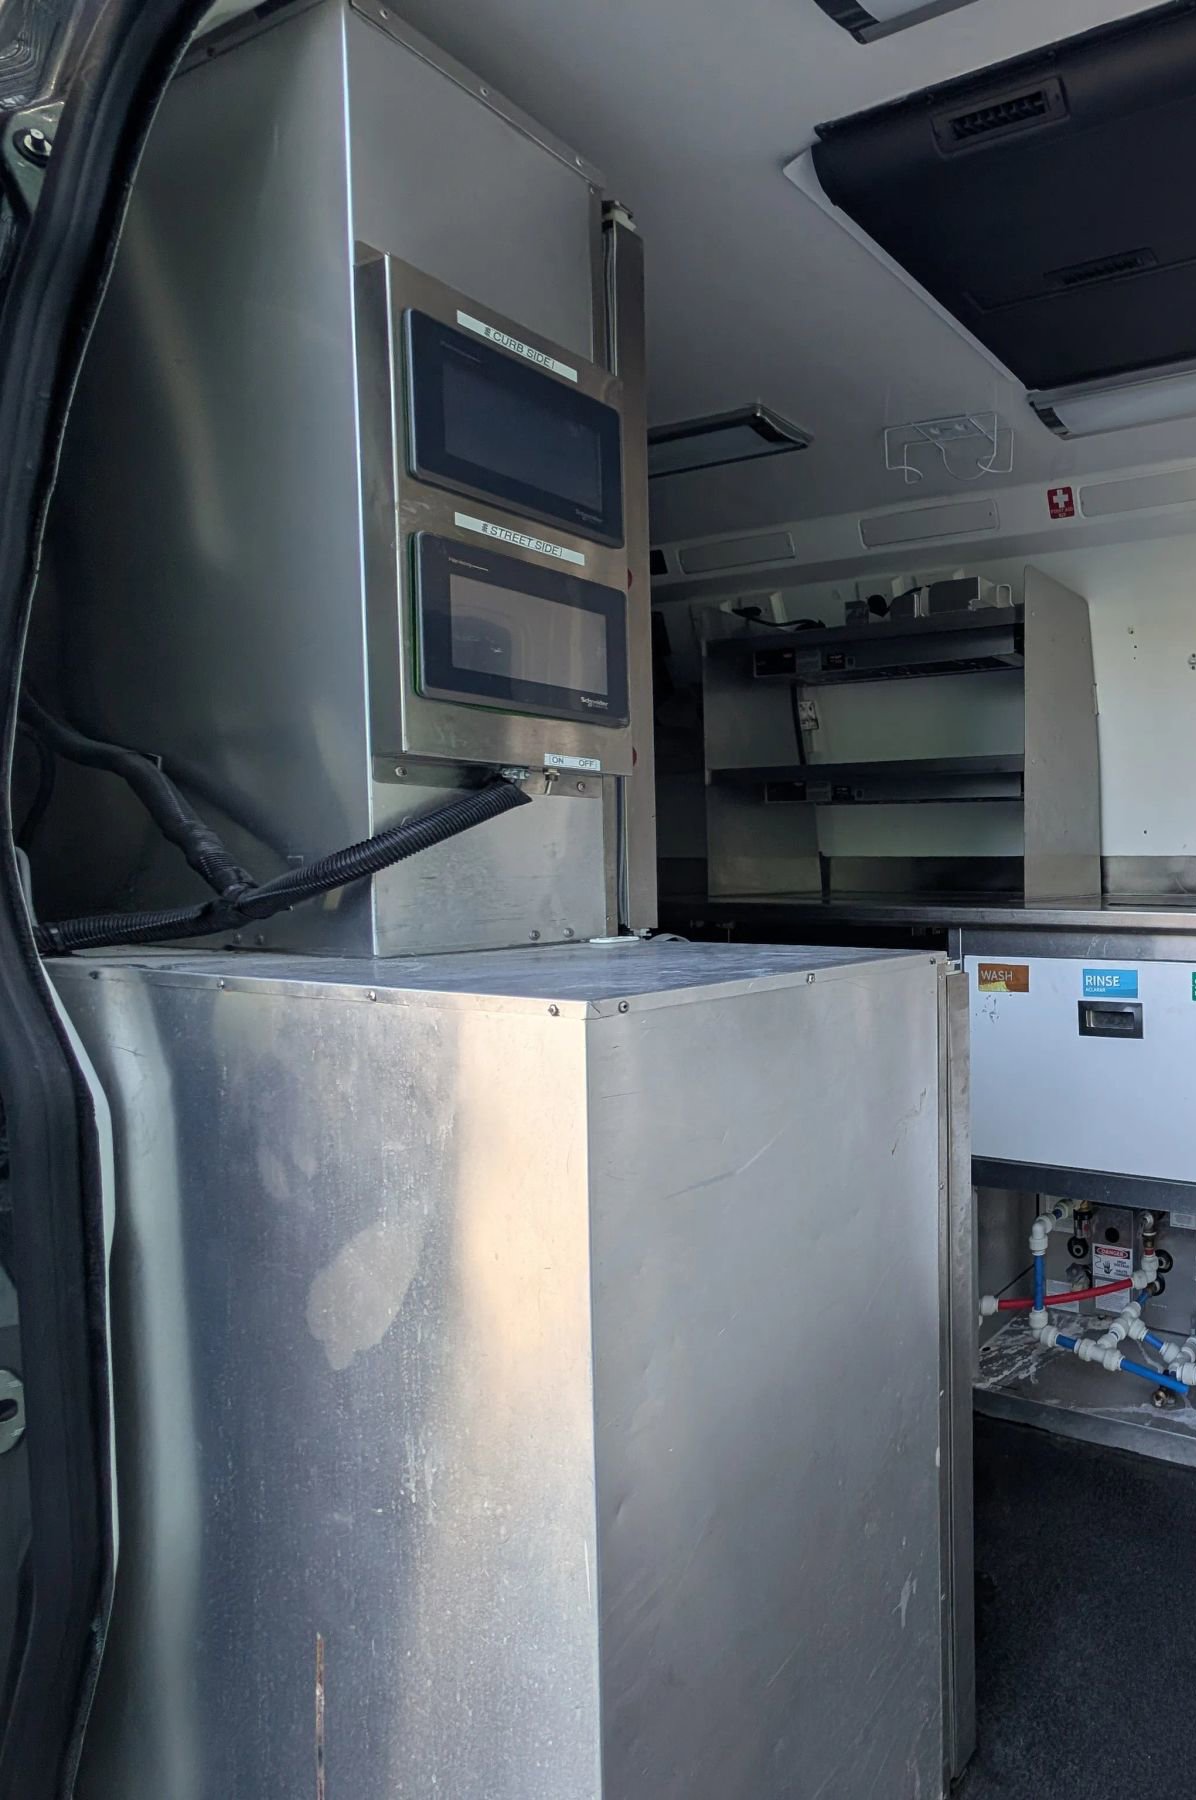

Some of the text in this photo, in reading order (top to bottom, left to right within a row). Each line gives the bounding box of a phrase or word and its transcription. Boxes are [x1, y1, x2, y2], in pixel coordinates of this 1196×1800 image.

[493, 331, 524, 353] CURB
[490, 526, 534, 546] STREET
[551, 756, 564, 764] ON
[980, 970, 1013, 982] WASH
[1085, 975, 1121, 987] RINSE
[1101, 1248, 1124, 1257] DANGER
